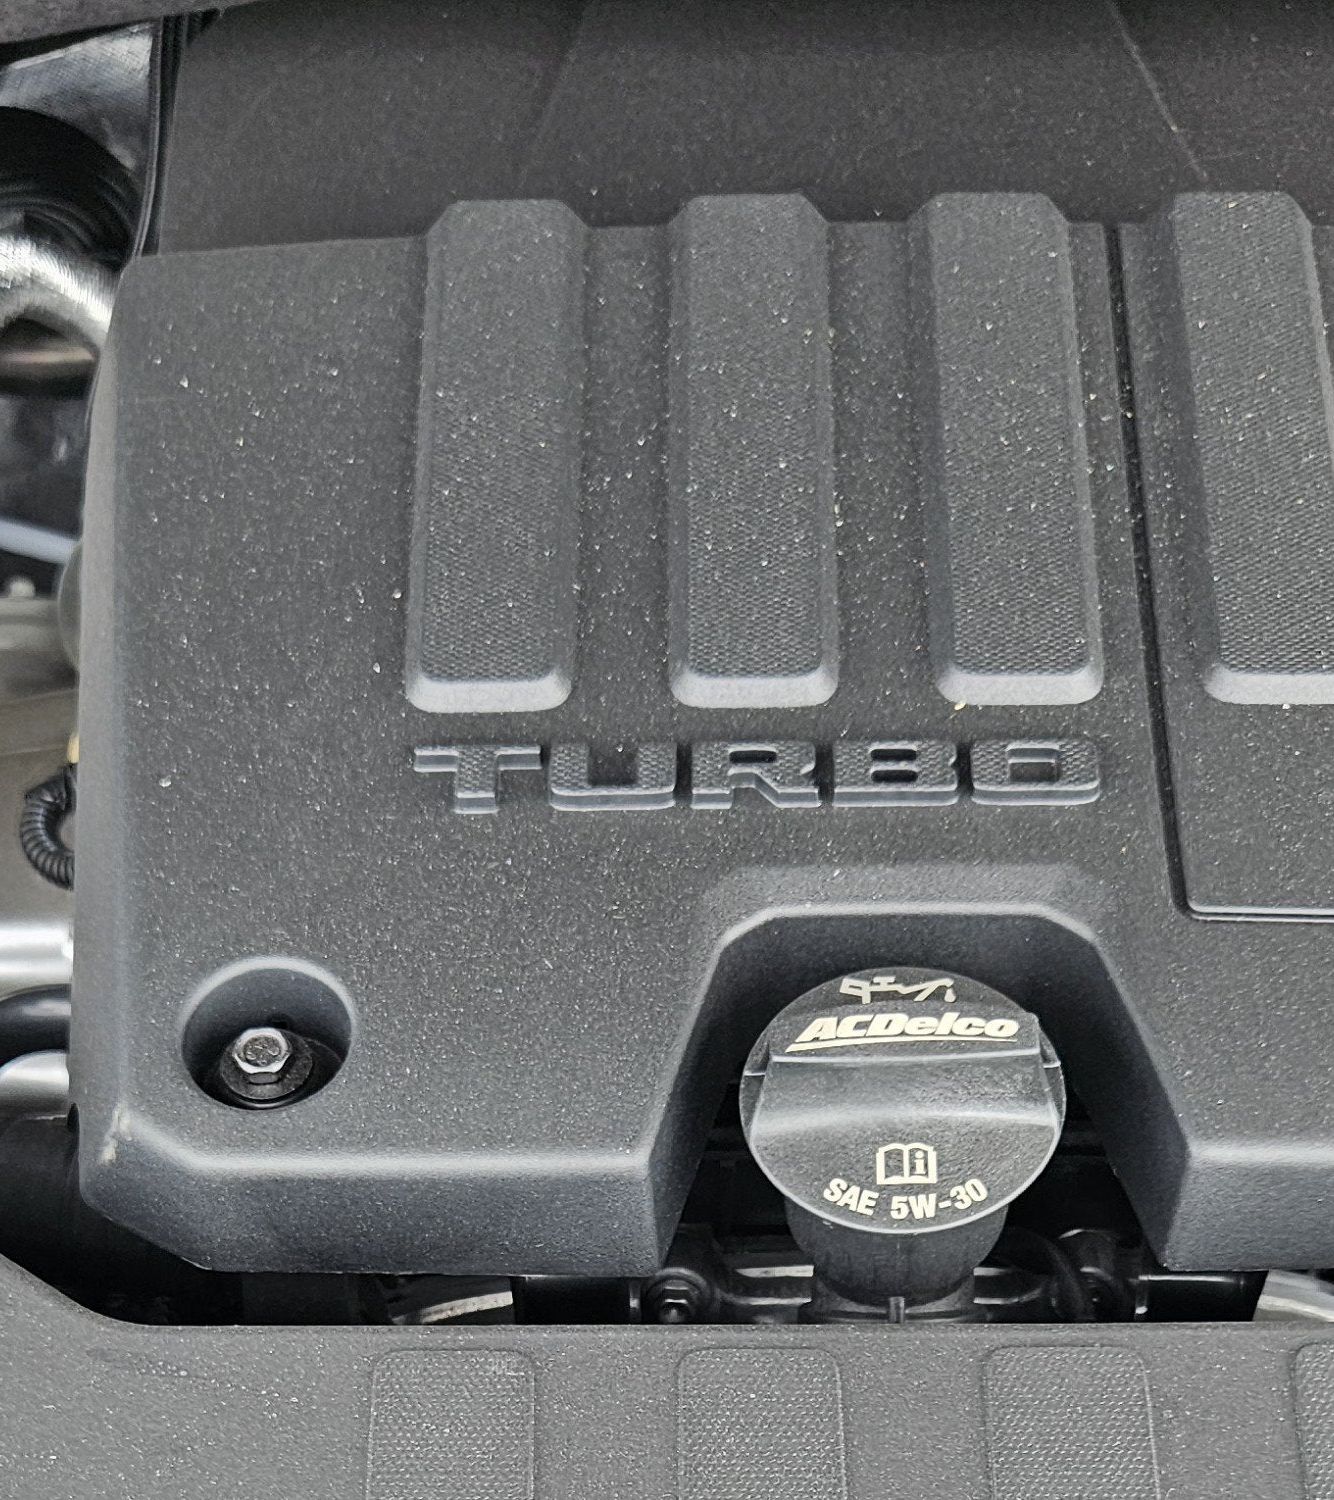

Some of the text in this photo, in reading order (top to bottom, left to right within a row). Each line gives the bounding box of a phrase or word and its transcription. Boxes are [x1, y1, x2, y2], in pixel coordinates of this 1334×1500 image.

[413, 740, 1101, 814] TURBO
[794, 1012, 1020, 1043] ACDelco
[823, 1178, 988, 1220] SAE 5W-30
